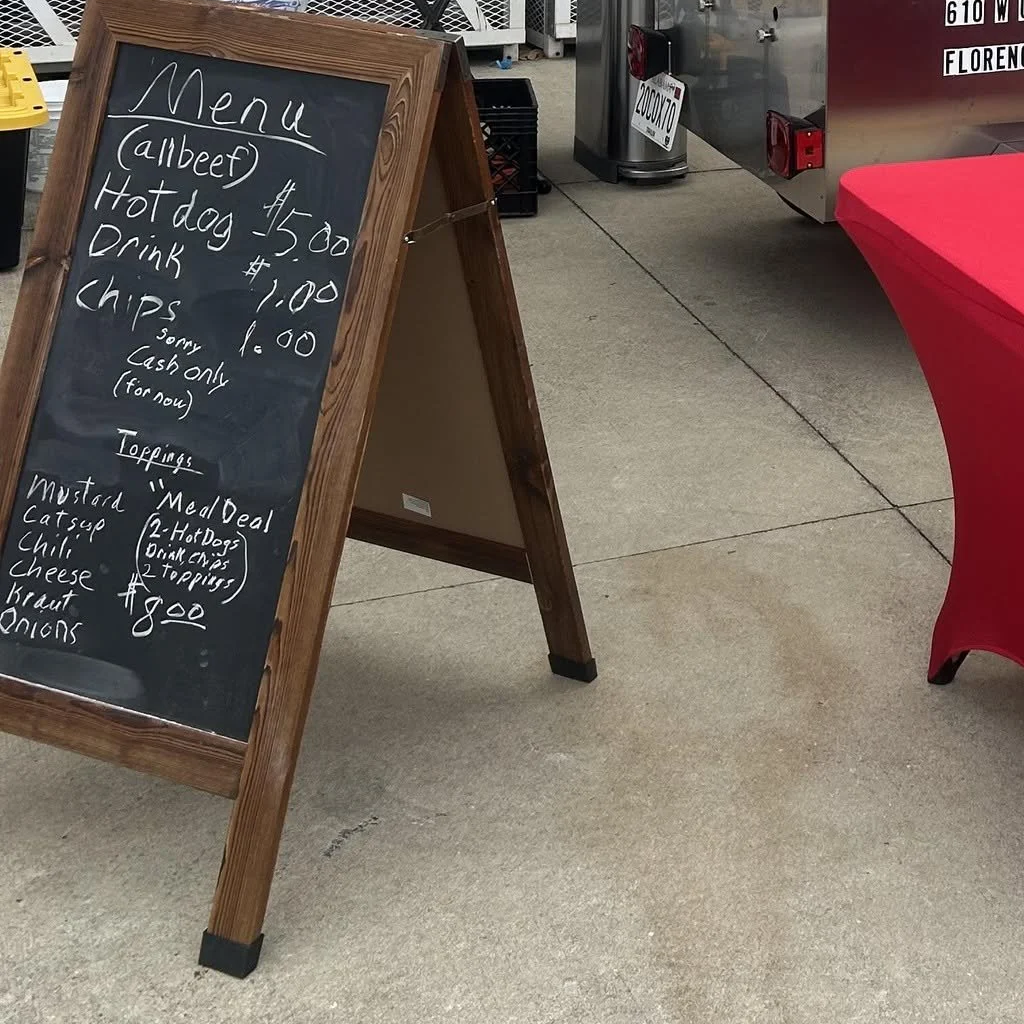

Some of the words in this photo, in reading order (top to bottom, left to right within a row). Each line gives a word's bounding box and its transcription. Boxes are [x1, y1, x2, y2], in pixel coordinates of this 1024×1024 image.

[947, 0, 983, 25] 610
[128, 61, 312, 139] Menu
[88, 223, 187, 279] Drink
[75, 275, 181, 332] Chips
[126, 345, 178, 376] Cash
[184, 360, 231, 396] only
[116, 427, 193, 475] Toppings
[23, 504, 106, 543] Catsup
[222, 497, 274, 534] Deal
[18, 530, 72, 560] Chili
[9, 556, 95, 592] Cheese
[5, 581, 79, 614] Kraut
[0, 606, 83, 645] Onions
